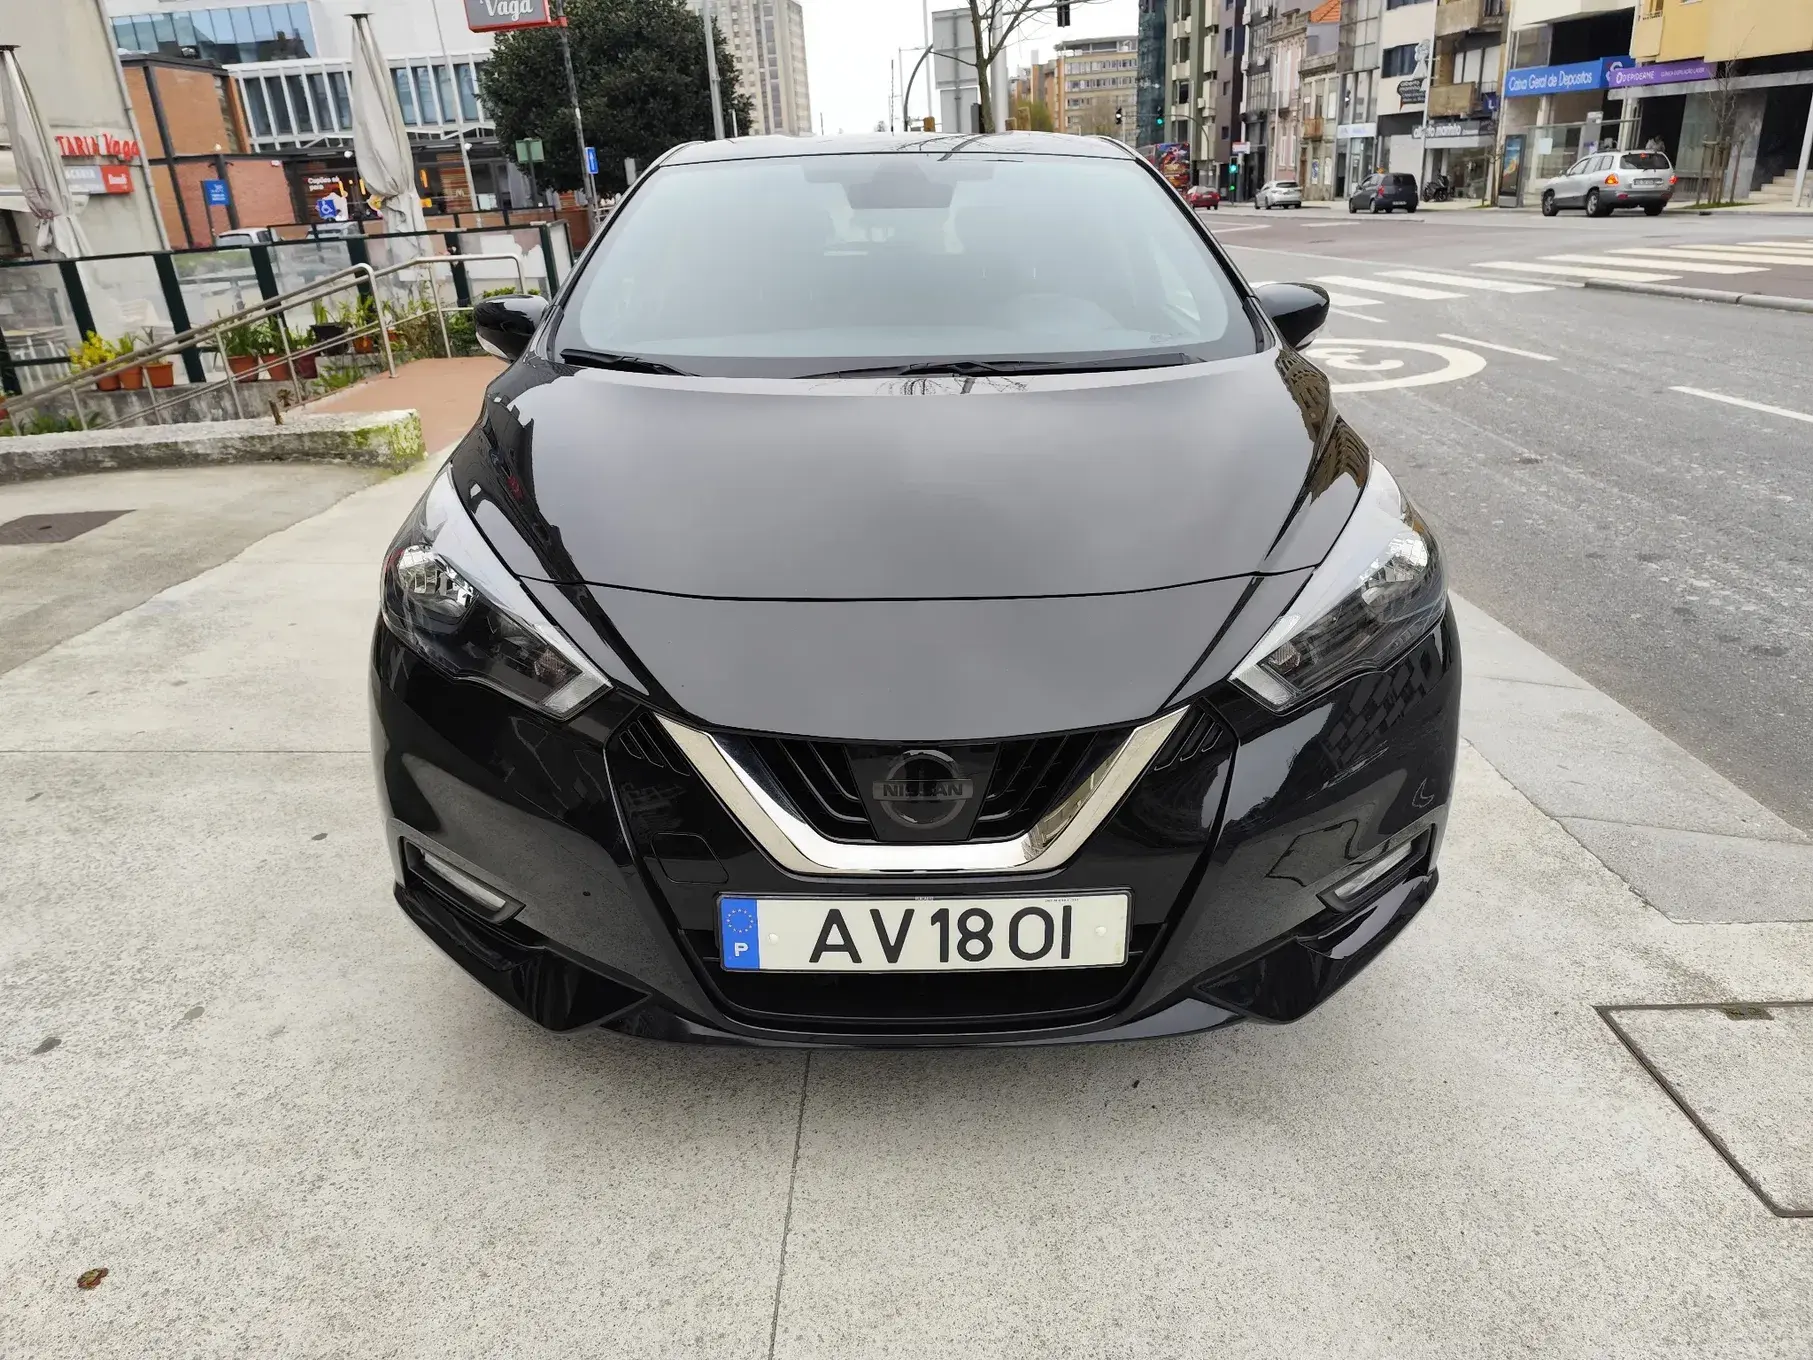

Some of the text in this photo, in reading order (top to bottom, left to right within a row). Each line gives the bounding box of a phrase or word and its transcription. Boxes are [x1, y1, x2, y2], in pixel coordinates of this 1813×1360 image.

[480, 0, 534, 21] Vaga
[1508, 76, 1527, 91] Caixa
[1528, 74, 1548, 90] Geral
[1547, 73, 1558, 88] de
[102, 133, 140, 161] Vaga
[734, 942, 749, 957] P
